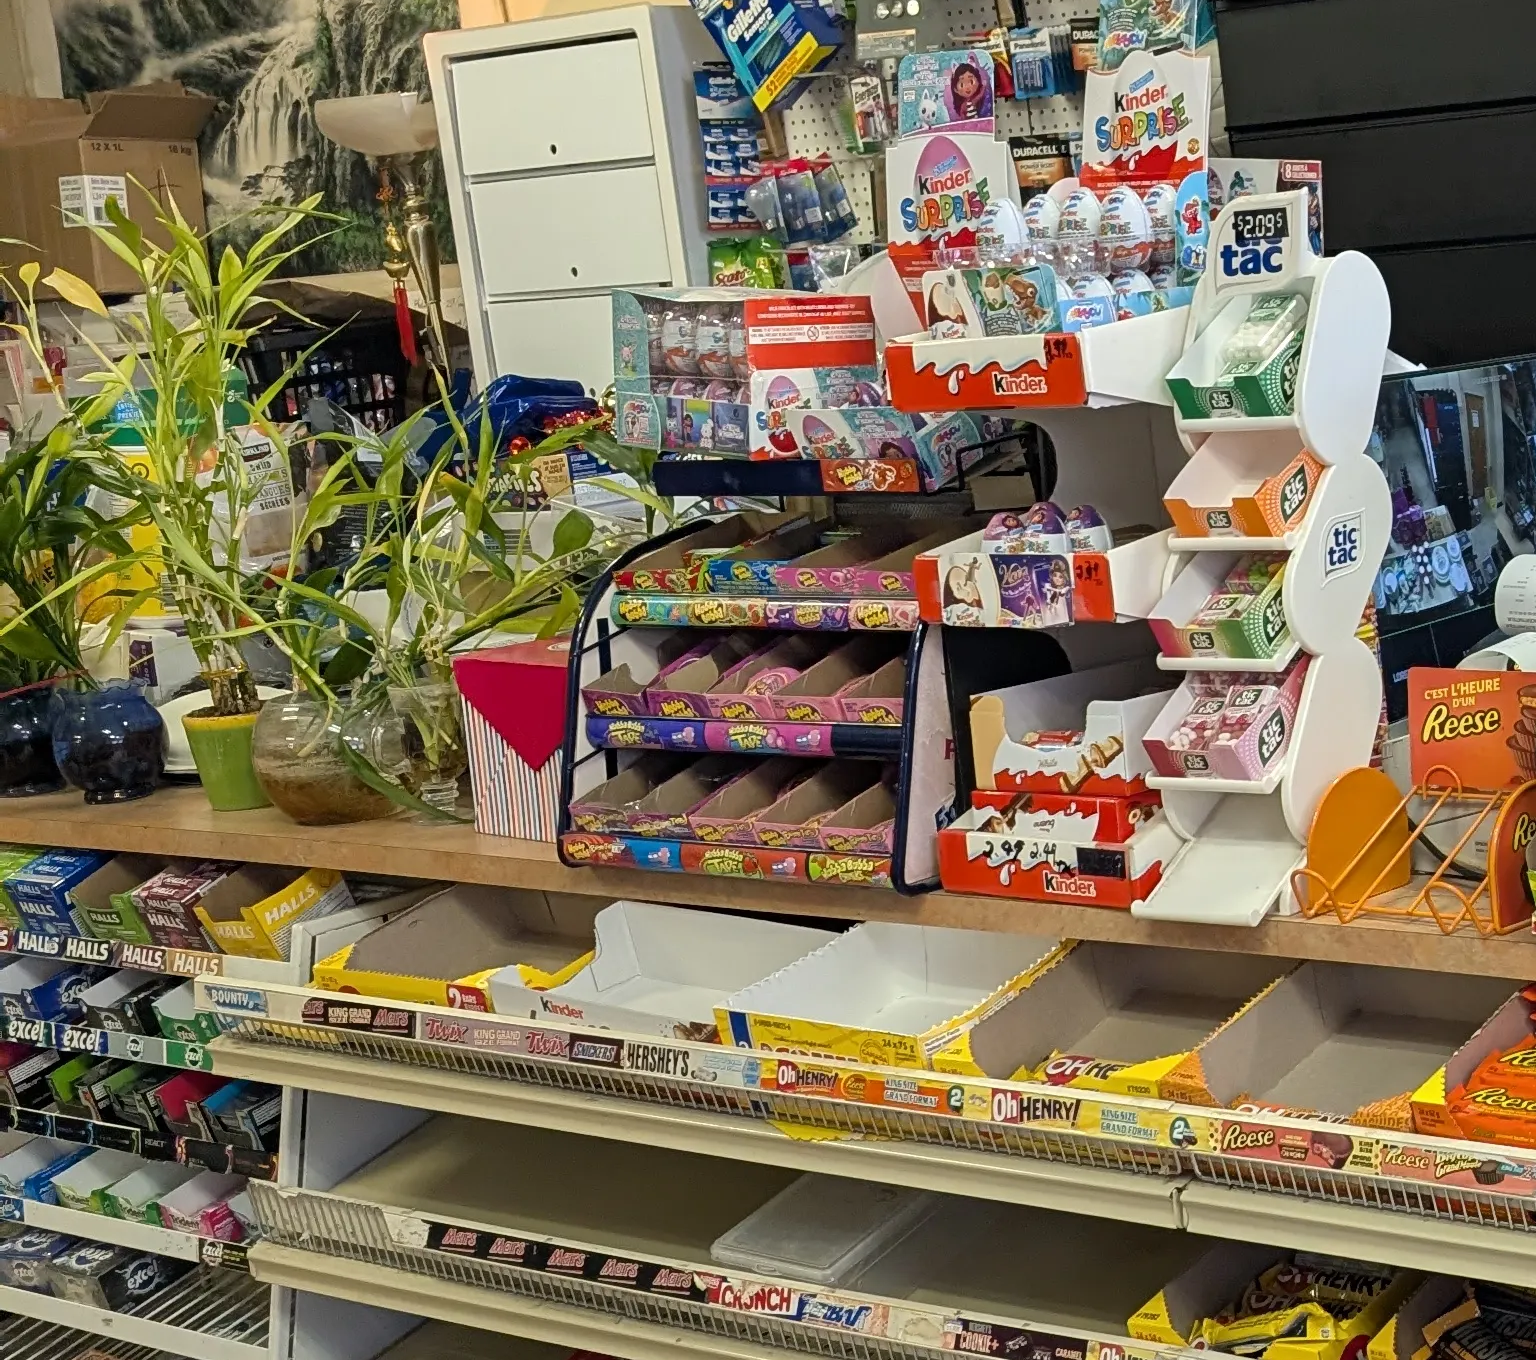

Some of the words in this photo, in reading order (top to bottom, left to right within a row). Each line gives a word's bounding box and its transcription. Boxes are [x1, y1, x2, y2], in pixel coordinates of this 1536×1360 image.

[1114, 83, 1168, 112] Kinder
[1095, 92, 1189, 152] SURPRISE
[1013, 146, 1058, 158] DURACELL
[918, 168, 973, 195] Kinder
[1221, 245, 1283, 276] tac
[994, 373, 1047, 395] Kinder
[1332, 524, 1357, 547] tic
[1328, 544, 1357, 566] tac
[1424, 685, 1449, 701] C'EST
[1451, 677, 1500, 697] L'HEURE
[1452, 696, 1475, 708] D'UN
[1422, 705, 1499, 743] Reese
[1043, 872, 1096, 897] Kinder
[265, 884, 316, 925] HALLS
[18, 932, 59, 954] HALLS
[66, 938, 109, 961] HALLS
[211, 989, 248, 1006] BOUNTY
[540, 995, 583, 1020] Kinder
[374, 1008, 409, 1027] Mars
[426, 1017, 468, 1040] Twix
[626, 1042, 690, 1078] HERSHEY'S
[1019, 1097, 1081, 1129] HENRY!
[1222, 1125, 1276, 1152] Reese
[720, 1284, 793, 1314] CRUNCH
